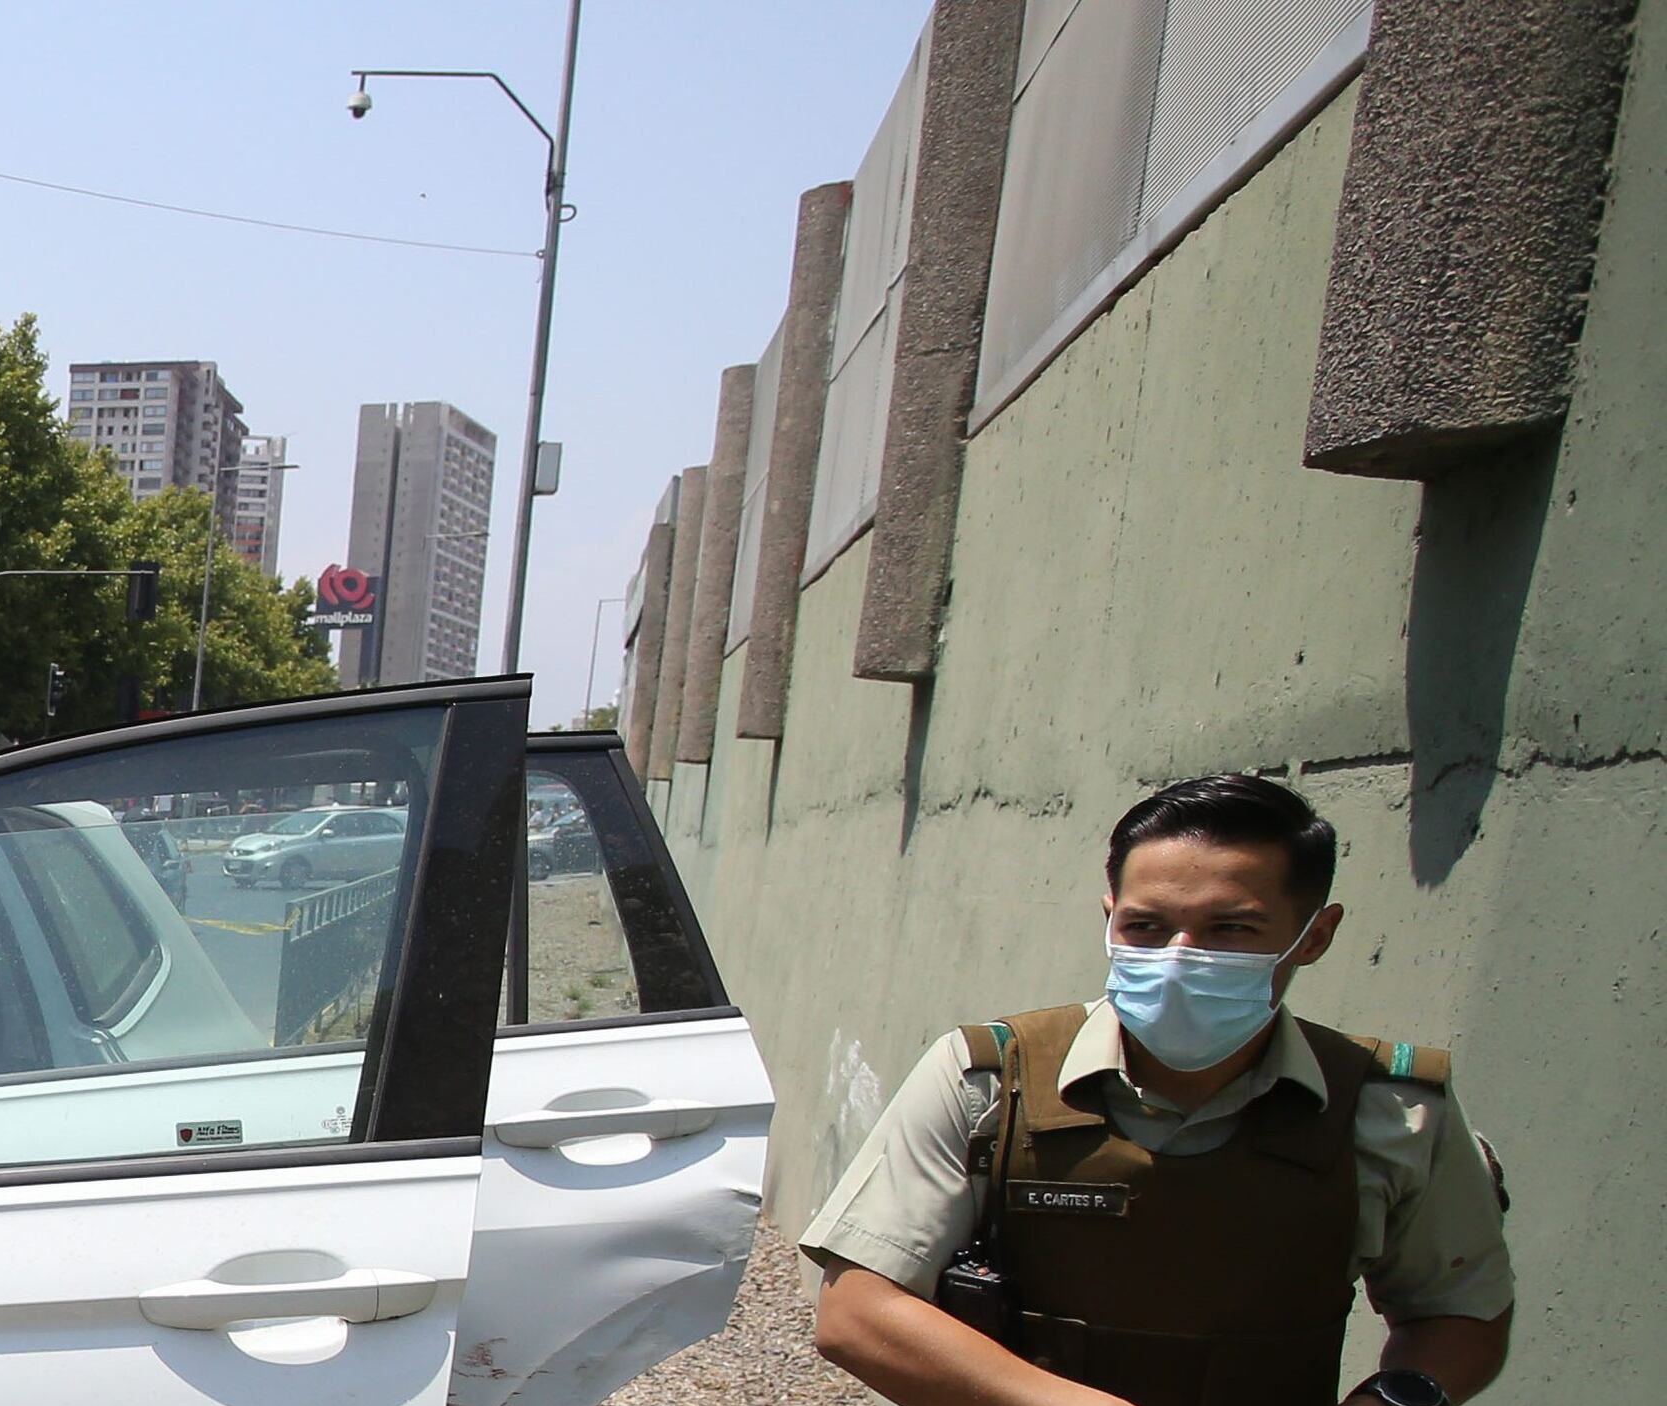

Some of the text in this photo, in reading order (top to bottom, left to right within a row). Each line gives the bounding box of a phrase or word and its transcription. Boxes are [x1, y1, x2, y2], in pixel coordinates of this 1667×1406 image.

[316, 611, 373, 627] mallplaza
[1028, 1192, 1107, 1207] E. CARTES P.
